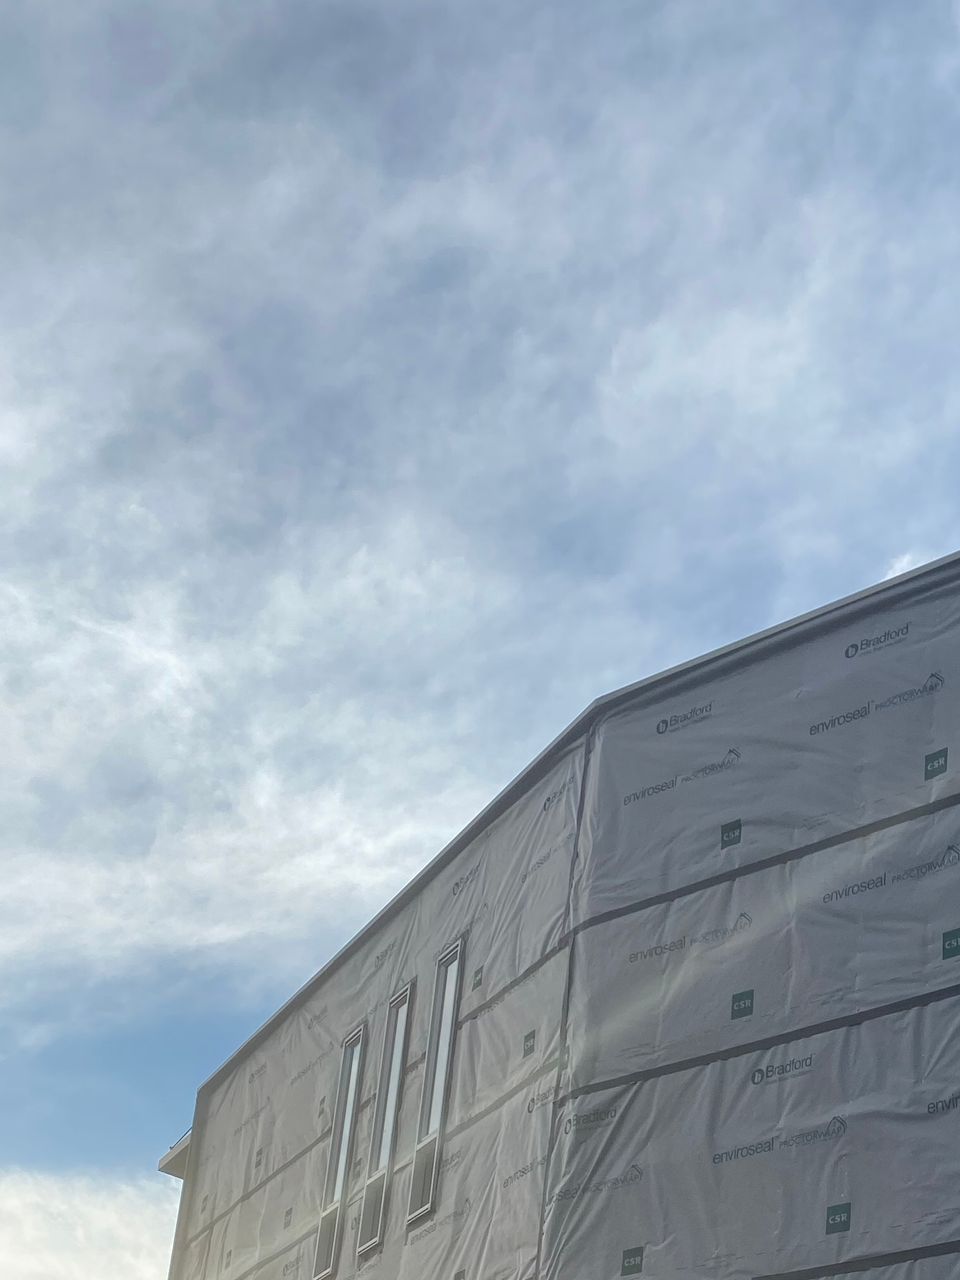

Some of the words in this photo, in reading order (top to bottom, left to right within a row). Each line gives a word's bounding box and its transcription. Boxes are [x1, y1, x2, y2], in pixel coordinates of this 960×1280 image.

[859, 624, 909, 650] Bradford
[809, 702, 871, 736] enviroseal
[624, 776, 677, 806] enviroseal
[823, 873, 887, 904] enviroseal
[765, 1055, 813, 1079] Bradford
[712, 1137, 774, 1164] enviroseal
[829, 1212, 848, 1223] CSR
